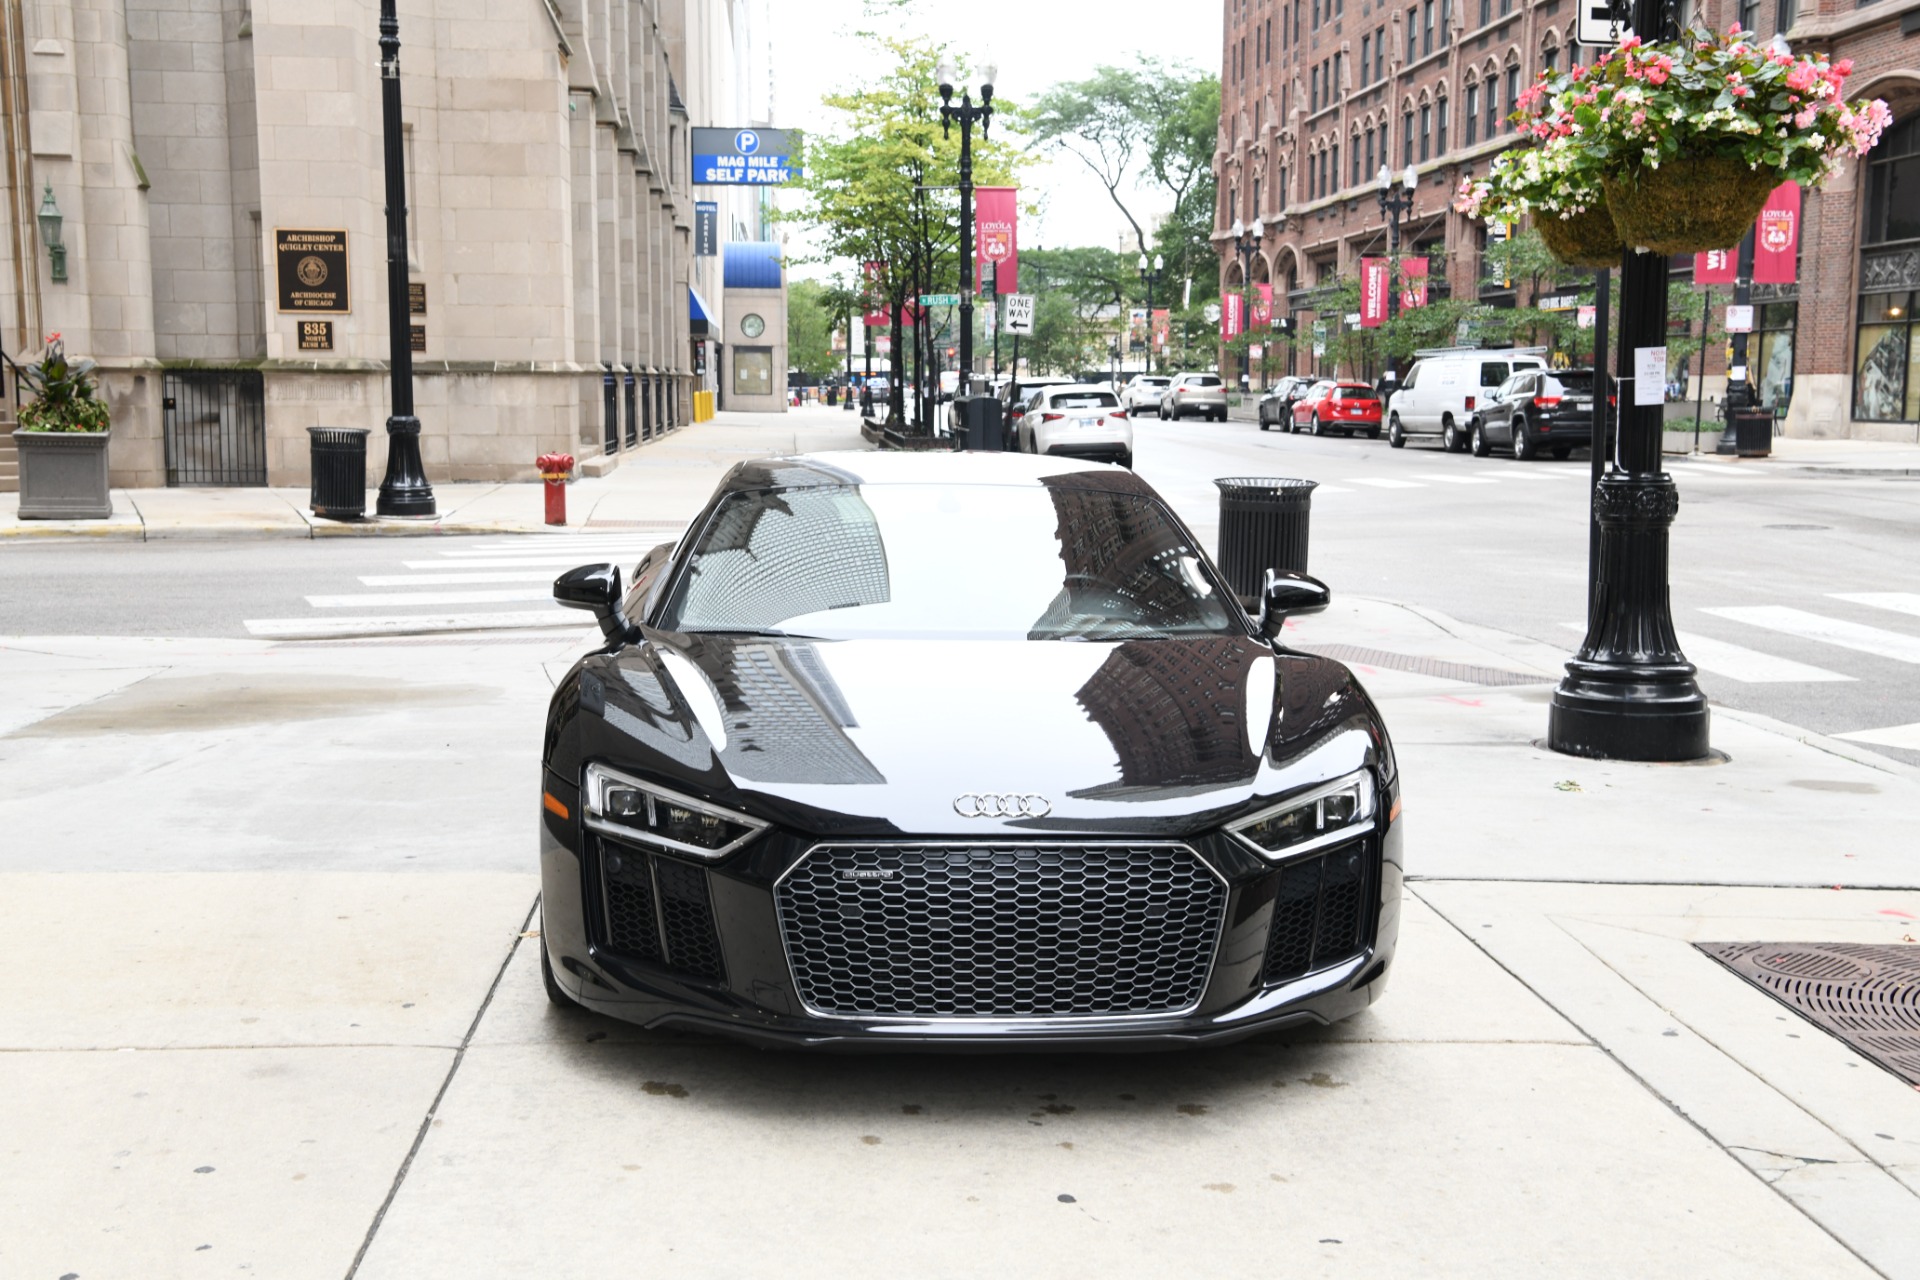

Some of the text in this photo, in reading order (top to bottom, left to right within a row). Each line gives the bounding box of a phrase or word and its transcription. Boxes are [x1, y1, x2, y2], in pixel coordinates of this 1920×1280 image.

[717, 156, 778, 167] MAG MILE
[706, 168, 789, 182] SELF PARK
[981, 222, 1012, 230] LOYOLA
[286, 234, 336, 242] ARCHBISHOP
[279, 243, 312, 251] QUIGLEY
[1367, 266, 1377, 319] WELCOME
[928, 296, 949, 305] RUSH
[1009, 298, 1031, 308] ONE
[1008, 309, 1030, 318] WAY
[304, 323, 327, 335] 835
